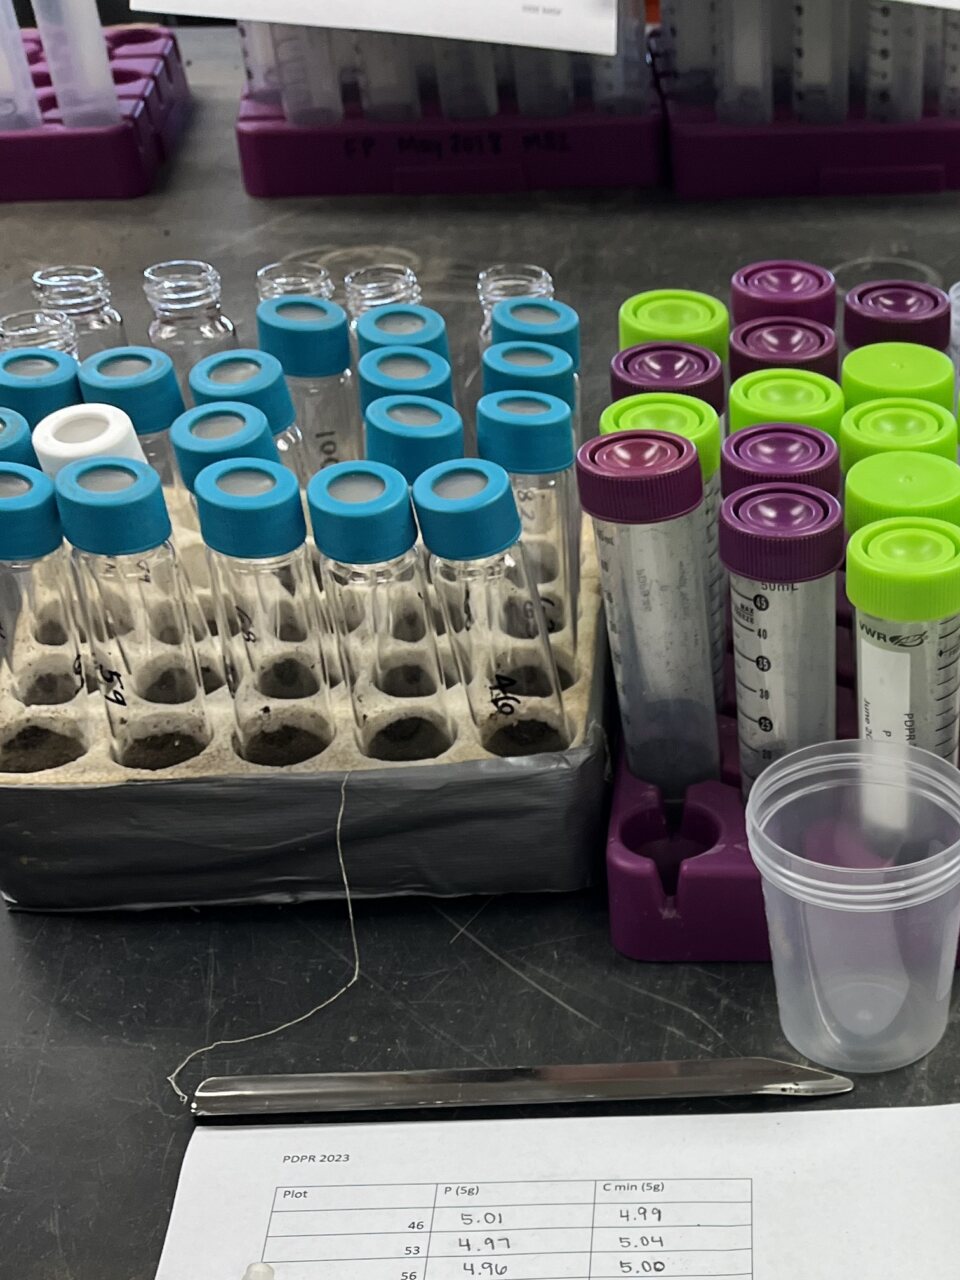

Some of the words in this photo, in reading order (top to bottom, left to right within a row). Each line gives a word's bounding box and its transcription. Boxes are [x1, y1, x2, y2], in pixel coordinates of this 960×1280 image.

[859, 623, 888, 643] VWR
[97, 664, 128, 708] 59
[882, 729, 892, 738] P
[904, 713, 916, 742] PDPR
[282, 1154, 317, 1164] PDPR
[318, 1153, 351, 1163] 2023
[282, 1189, 309, 1199] Plot
[443, 1186, 453, 1195] P
[455, 1185, 480, 1197] (5g)
[602, 1182, 612, 1192] C
[614, 1183, 638, 1191] min
[640, 1181, 665, 1193] (5g)
[460, 1211, 503, 1226] 5.01
[619, 1206, 663, 1222] 4.99
[407, 1220, 425, 1231] 46
[457, 1236, 511, 1252] 4.97
[618, 1235, 664, 1249] 5.04
[404, 1245, 421, 1256] 53
[462, 1261, 508, 1276] 4.96
[618, 1260, 666, 1274] 5.00
